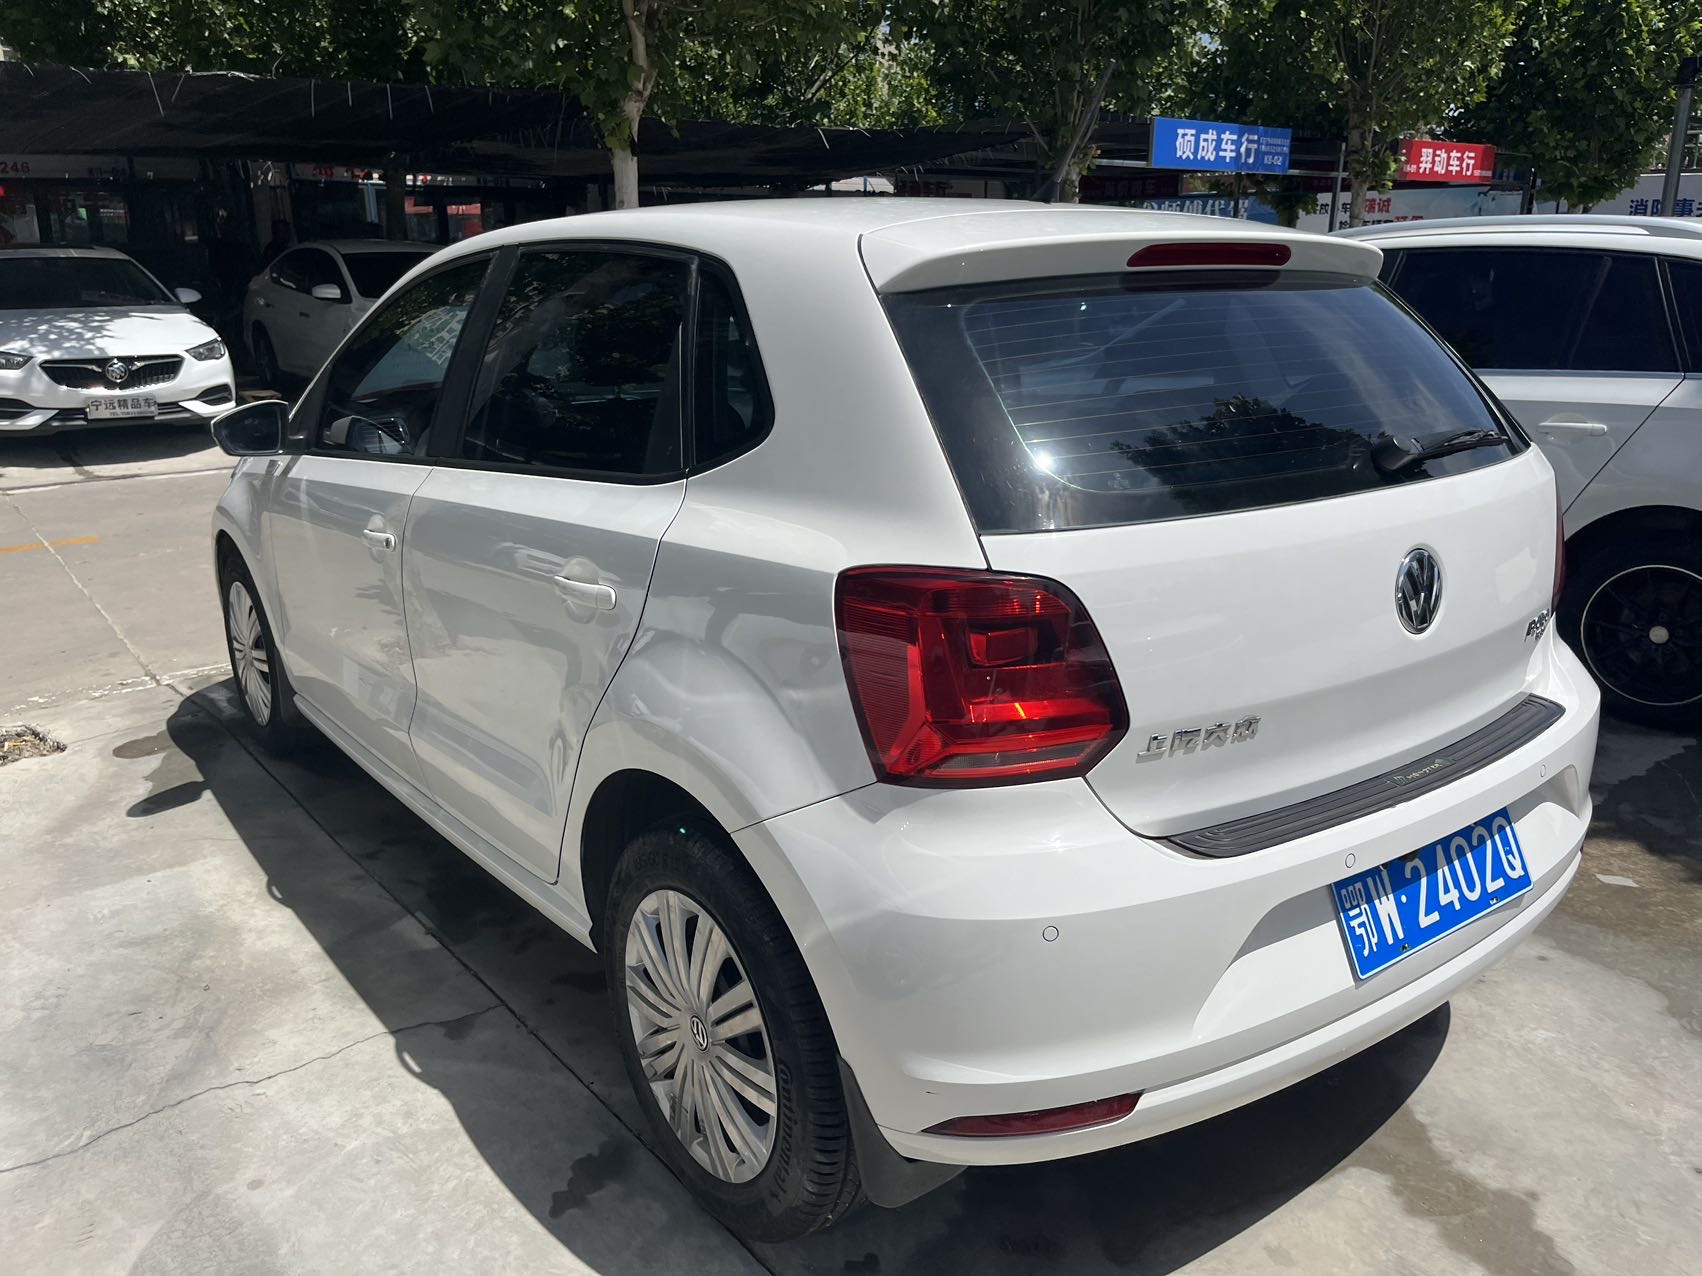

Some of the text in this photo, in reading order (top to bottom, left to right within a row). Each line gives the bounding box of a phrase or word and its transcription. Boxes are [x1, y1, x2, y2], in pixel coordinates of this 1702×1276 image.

[1175, 128, 1258, 164] 硕成车行
[1136, 716, 1261, 763] 上海大众
